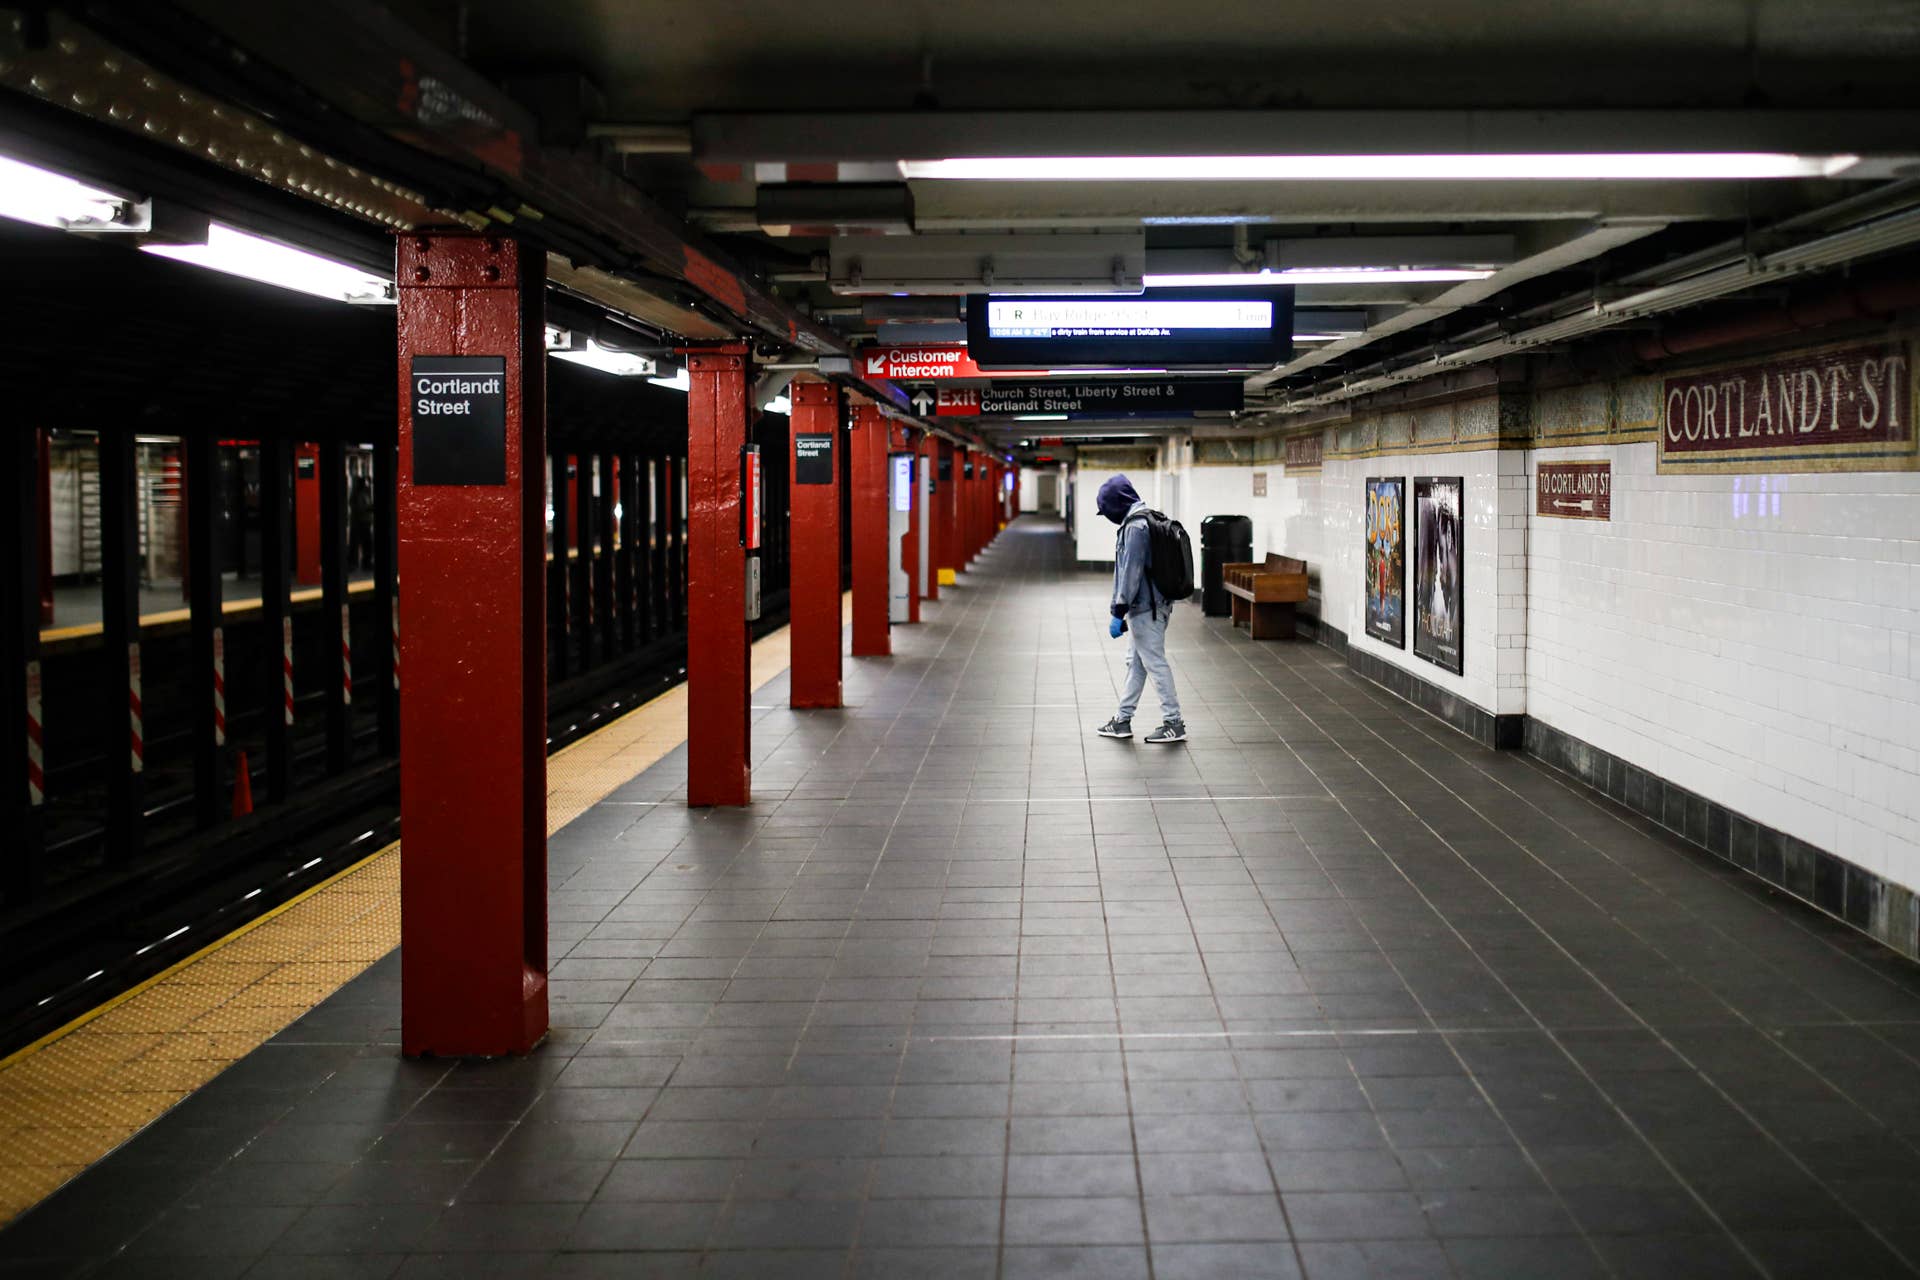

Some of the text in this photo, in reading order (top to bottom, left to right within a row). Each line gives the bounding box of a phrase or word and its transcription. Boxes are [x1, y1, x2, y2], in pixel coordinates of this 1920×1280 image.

[1014, 309, 1023, 320] R
[1012, 328, 1023, 337] AM
[1057, 328, 1072, 337] dirty
[1073, 328, 1088, 336] train
[1089, 328, 1104, 336] from
[1105, 328, 1128, 336] service
[1129, 328, 1136, 336] at
[1137, 328, 1160, 336] DeKalb
[889, 350, 961, 363] Customer
[889, 363, 954, 377] Intercom
[417, 378, 500, 395] Cortlandt
[981, 385, 1175, 399] Church Street, Liberty Street &
[938, 389, 977, 406] Exit
[417, 399, 470, 415] Street
[981, 399, 1082, 412] Cortlandt Street
[797, 441, 831, 449] Cortlandt
[797, 449, 819, 457] Street
[1540, 471, 1610, 496] TO CORTLANDT ST
[1369, 490, 1400, 548] DORA
